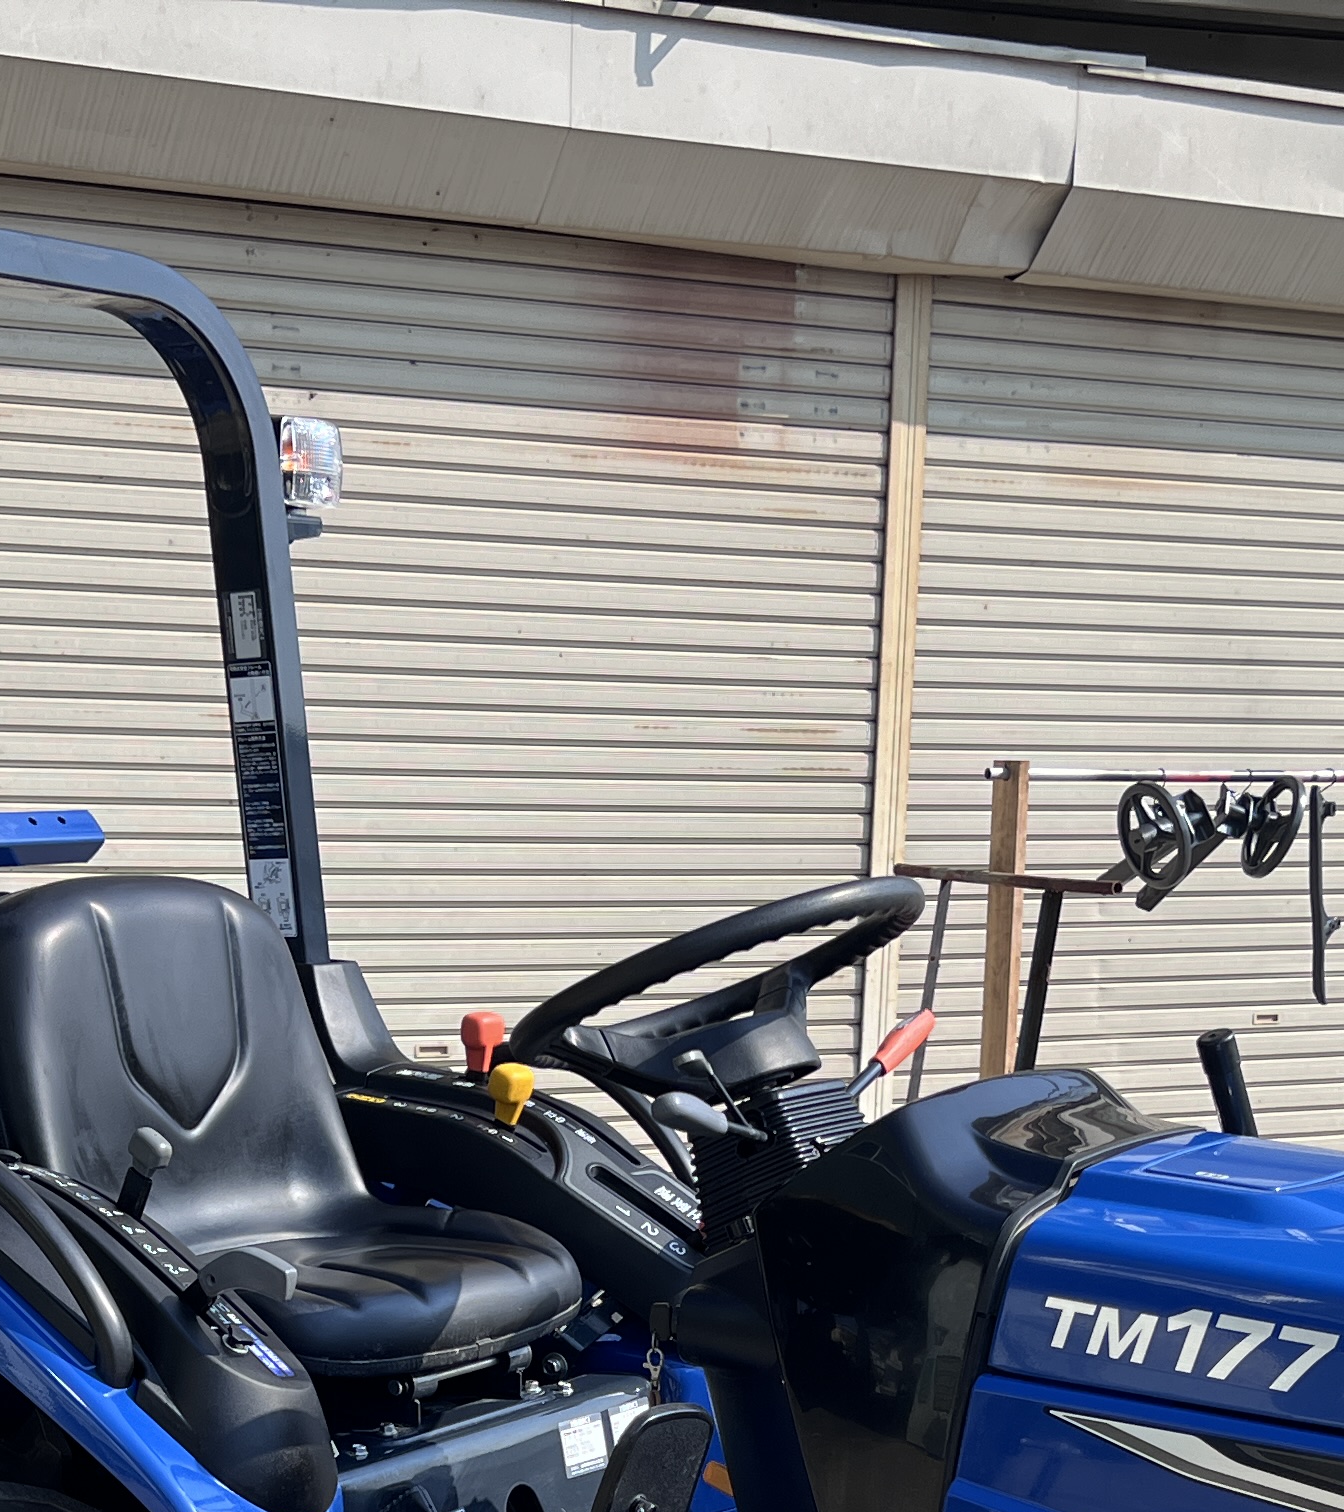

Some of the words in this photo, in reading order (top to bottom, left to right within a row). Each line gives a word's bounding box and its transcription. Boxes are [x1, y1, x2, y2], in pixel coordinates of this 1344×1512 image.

[640, 1221, 659, 1236] 2
[668, 1241, 687, 1256] 3
[1044, 1296, 1341, 1393] TM177
